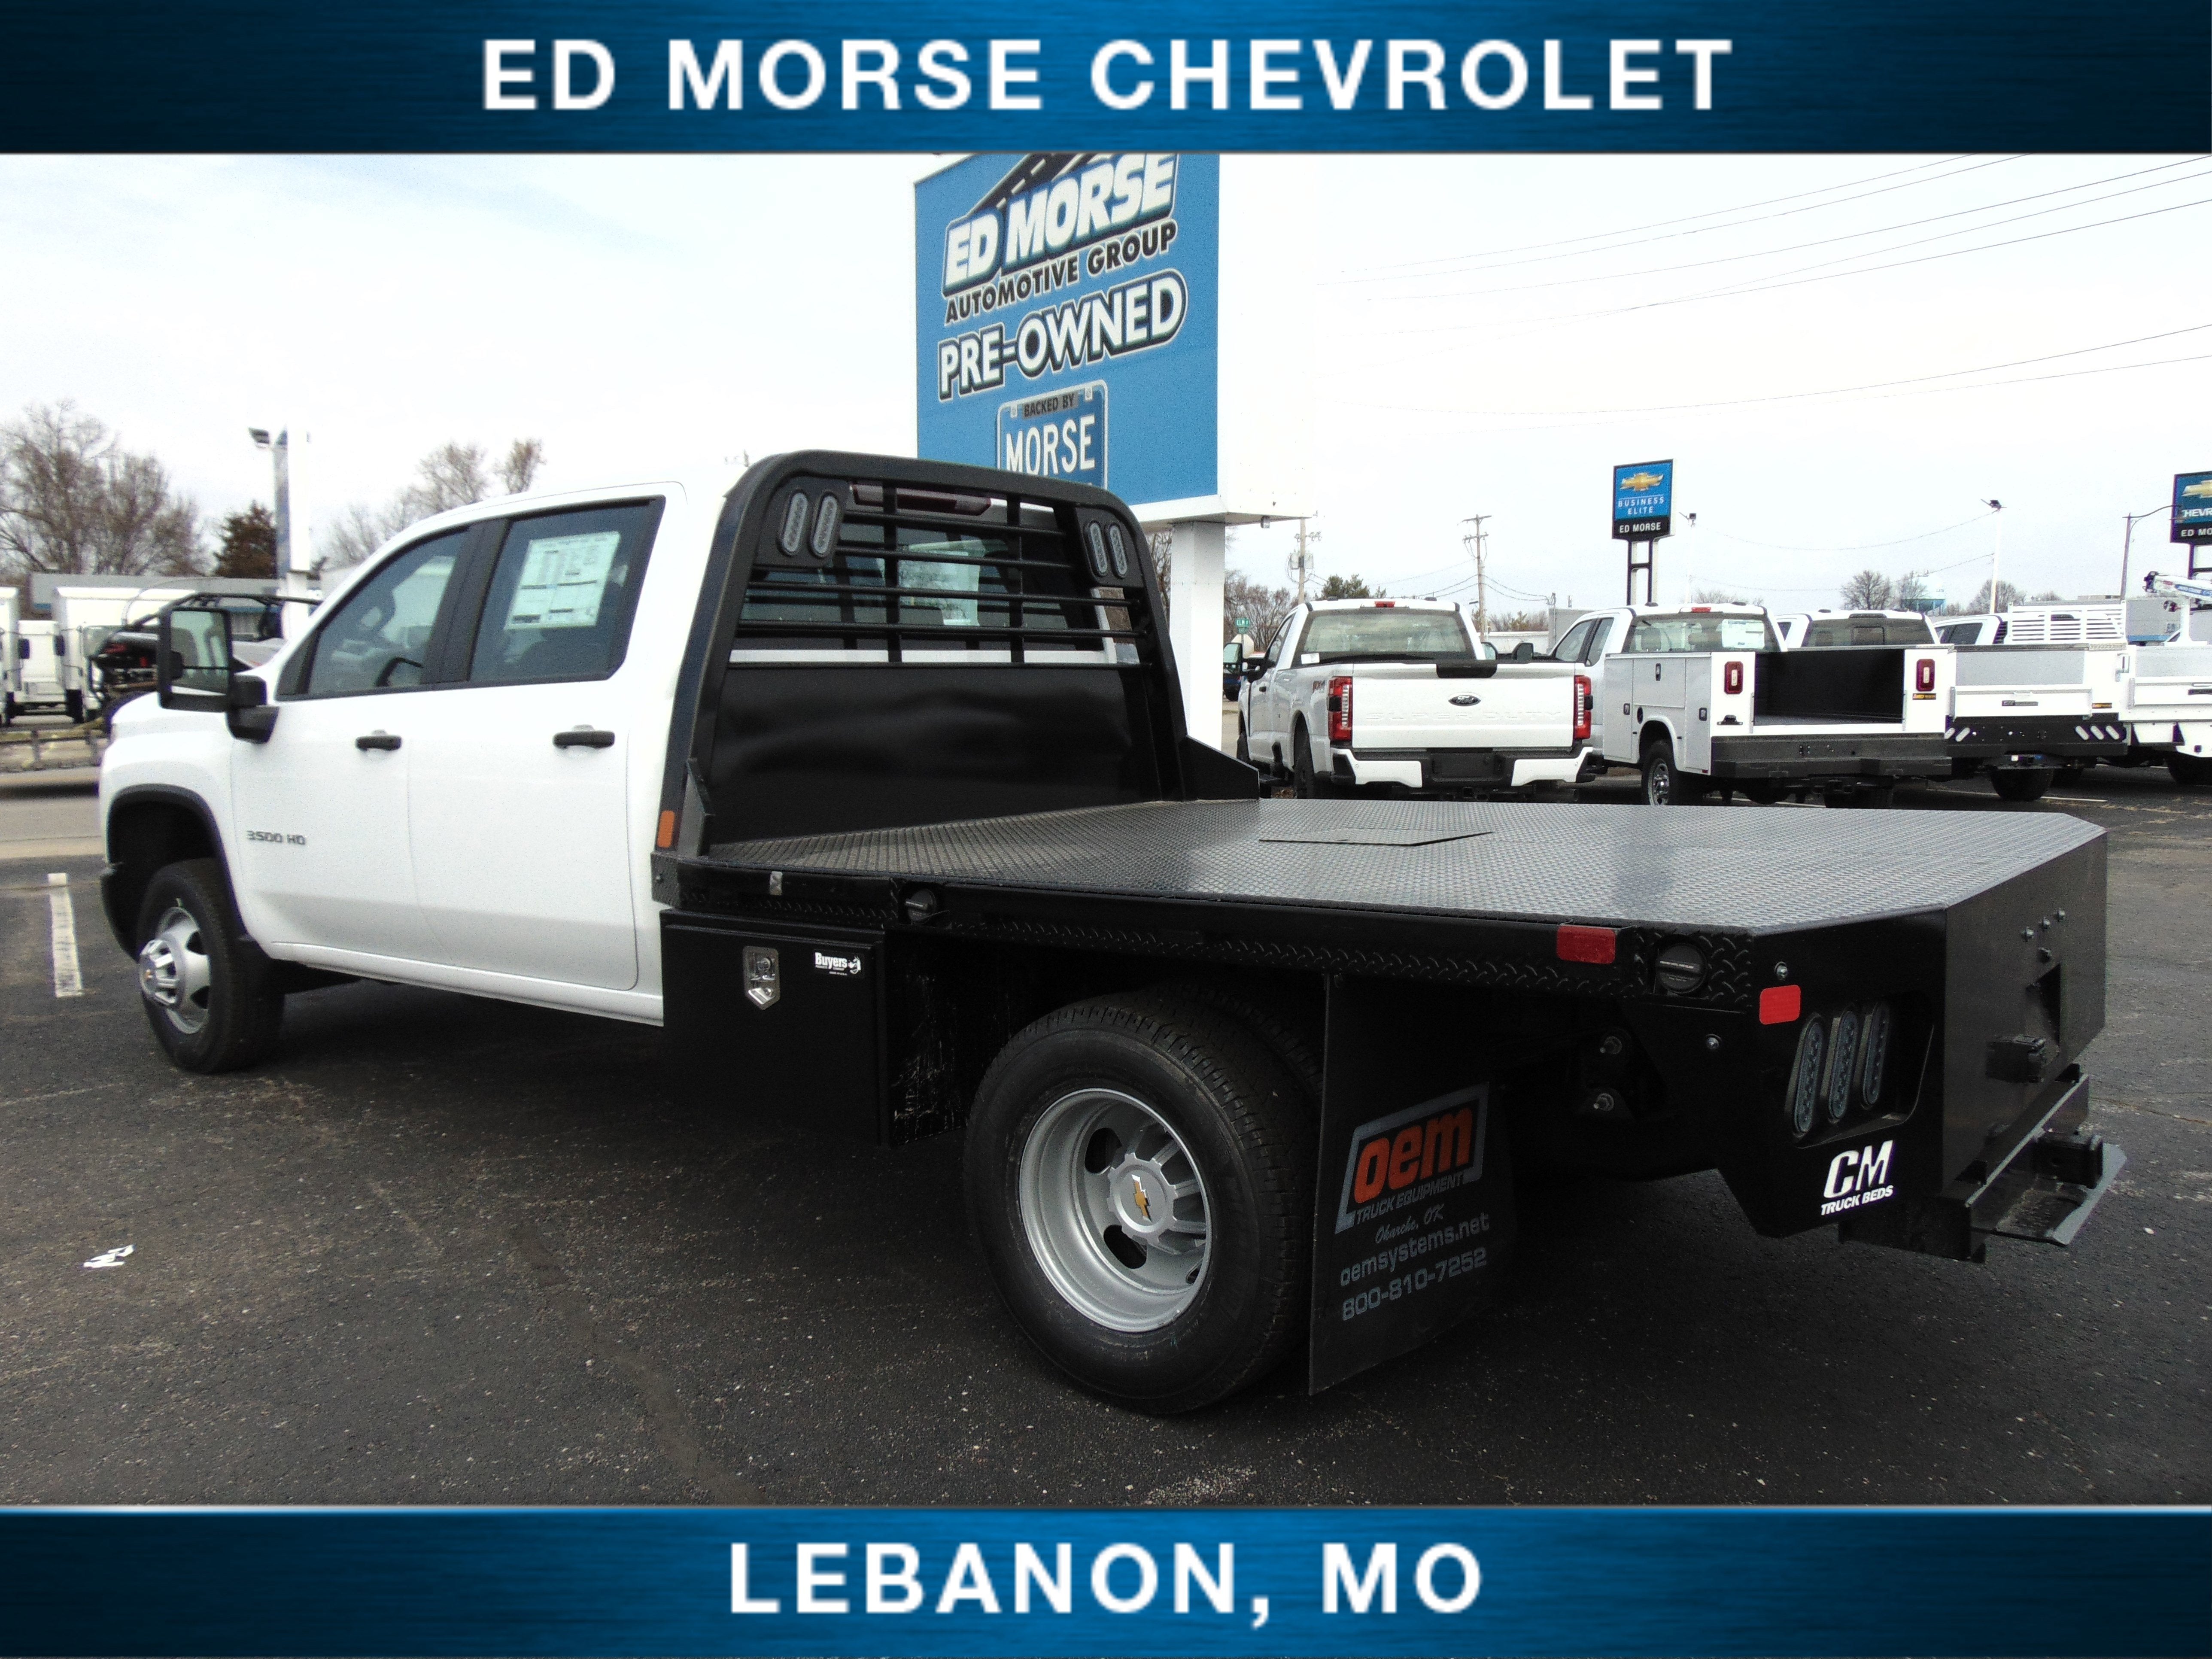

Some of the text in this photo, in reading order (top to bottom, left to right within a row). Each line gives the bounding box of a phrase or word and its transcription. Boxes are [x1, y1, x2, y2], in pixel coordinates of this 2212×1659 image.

[945, 153, 1175, 289] ED MORSE
[946, 222, 1176, 323] AUTOMOTIVE GROUP
[941, 276, 1183, 392] PRE-OWNED
[1024, 393, 1075, 418] BACKED BY
[1006, 415, 1095, 476] MORSE
[1618, 496, 1665, 507] BUSINESS
[1628, 506, 1653, 515] ELITE
[1620, 522, 1661, 533] ED MORSE
[2181, 529, 2194, 537] ED
[1456, 696, 1474, 704] Ford
[246, 830, 306, 845] 3500 HD
[815, 952, 848, 969] Buyers
[1353, 1108, 1473, 1203] oem
[1823, 1139, 1893, 1198] CM
[1356, 1170, 1464, 1225] TRUCK EQUIPMENT
[1821, 1185, 1894, 1215] TRUCK BEDS
[1423, 1203, 1445, 1226] OK
[1340, 1212, 1490, 1286] oemsystems.net
[1342, 1246, 1488, 1322] 800-810-7252
